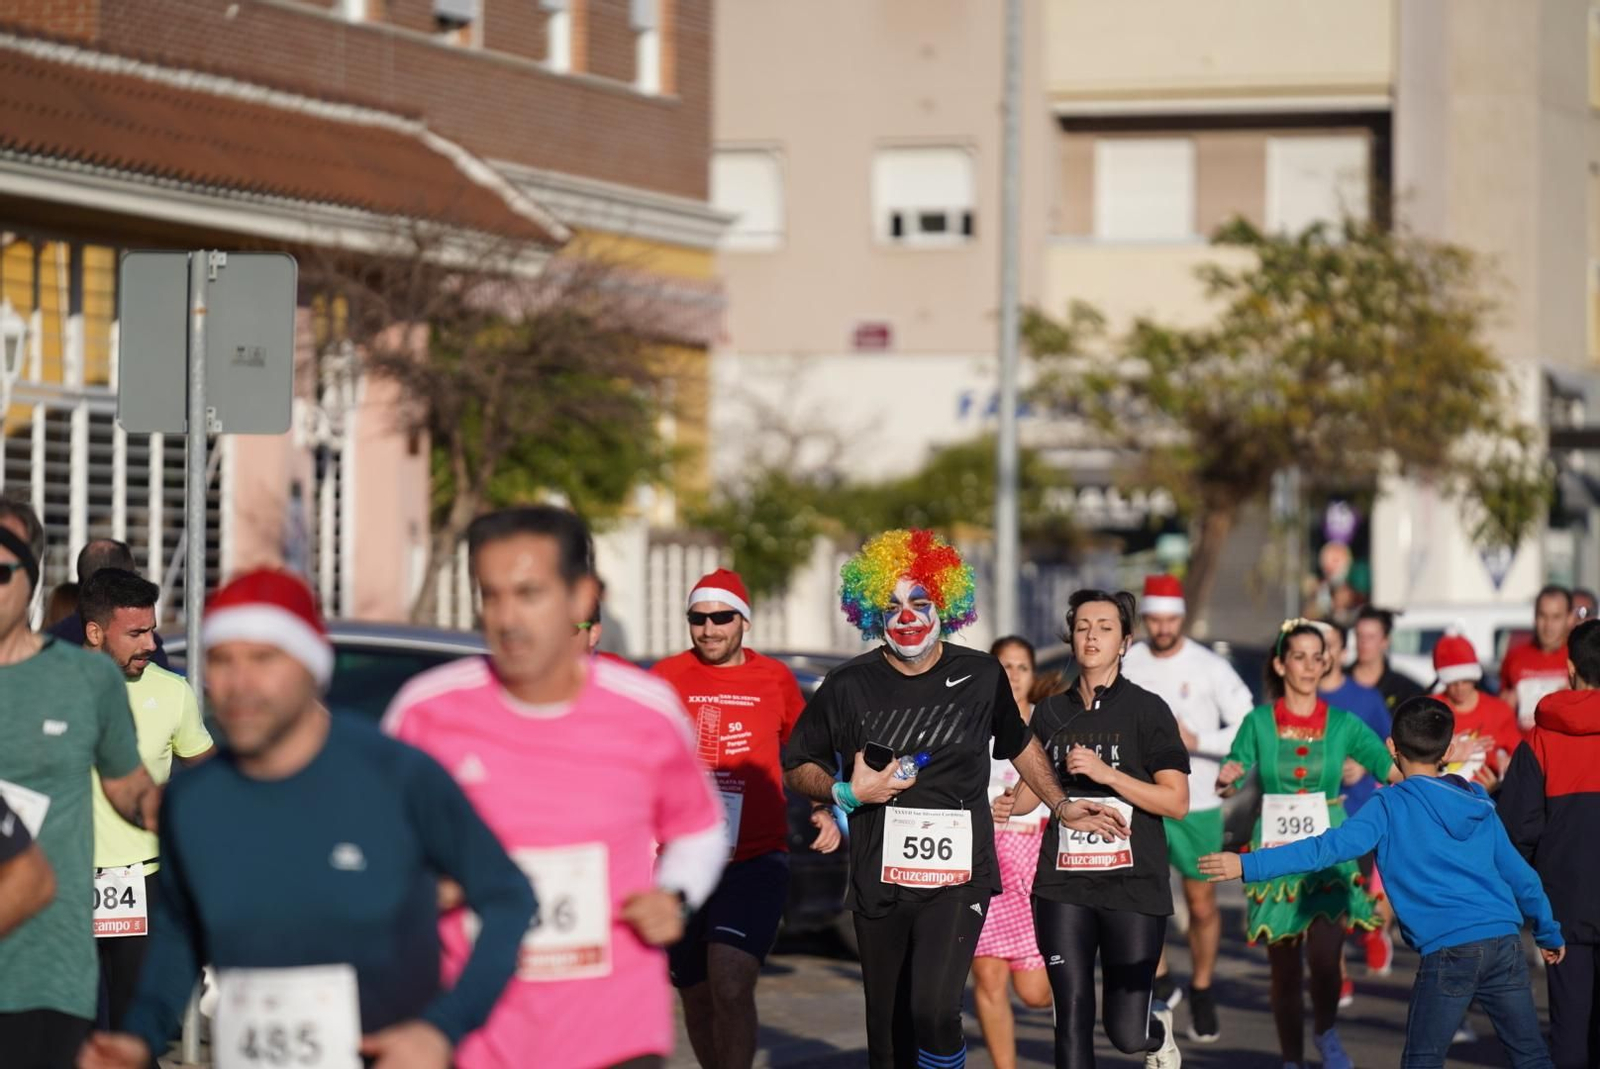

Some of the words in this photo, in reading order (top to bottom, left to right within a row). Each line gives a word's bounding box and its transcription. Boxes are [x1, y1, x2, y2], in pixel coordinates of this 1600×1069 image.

[728, 721, 742, 733] 50
[1277, 816, 1314, 835] 398
[903, 836, 953, 860] 596
[1062, 853, 1117, 867] Cruzcampo
[889, 868, 954, 885] Cruzcampo
